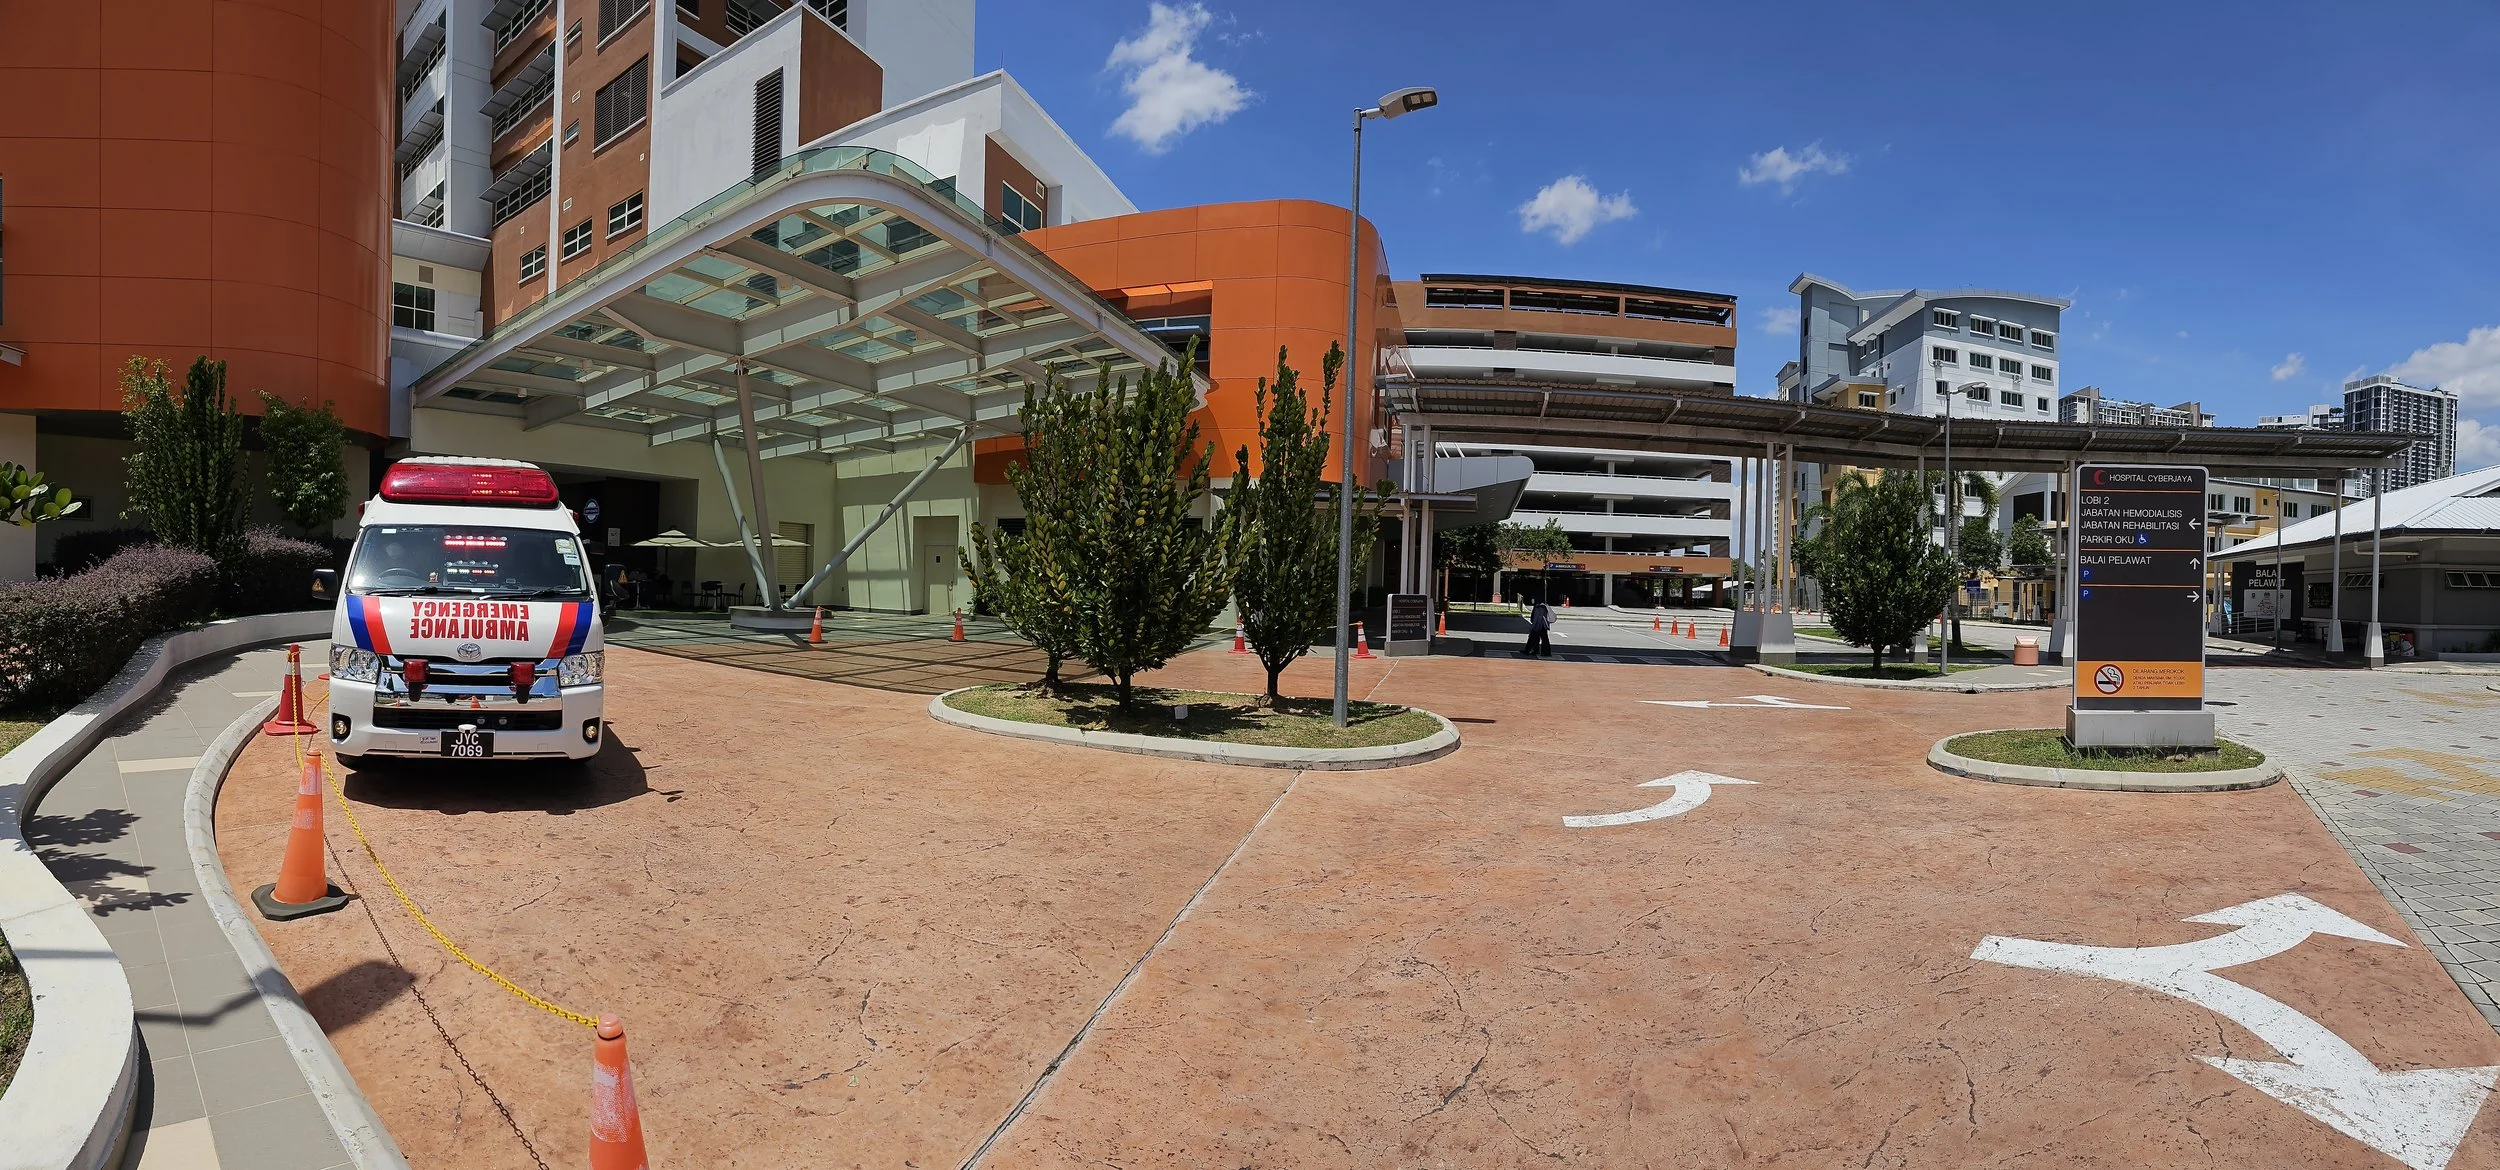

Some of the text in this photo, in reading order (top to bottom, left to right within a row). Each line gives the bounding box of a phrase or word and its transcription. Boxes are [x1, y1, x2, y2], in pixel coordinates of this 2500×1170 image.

[2109, 474, 2192, 483] HOSPITAL CYBERJAYA
[2081, 496, 2110, 504] LOBI 2
[2081, 509, 2183, 518] JABATAN HEMODIALISIS
[2081, 521, 2180, 530] JABATAN REHABILITASI
[2080, 535, 2135, 544] PARKIR OKU
[2080, 555, 2152, 565] BALAI PELAWAT
[2083, 570, 2090, 578] P
[2256, 569, 2277, 578] BALA
[2248, 579, 2286, 587] PELAWT
[455, 733, 479, 745] JYC
[450, 744, 483, 757] 7069
